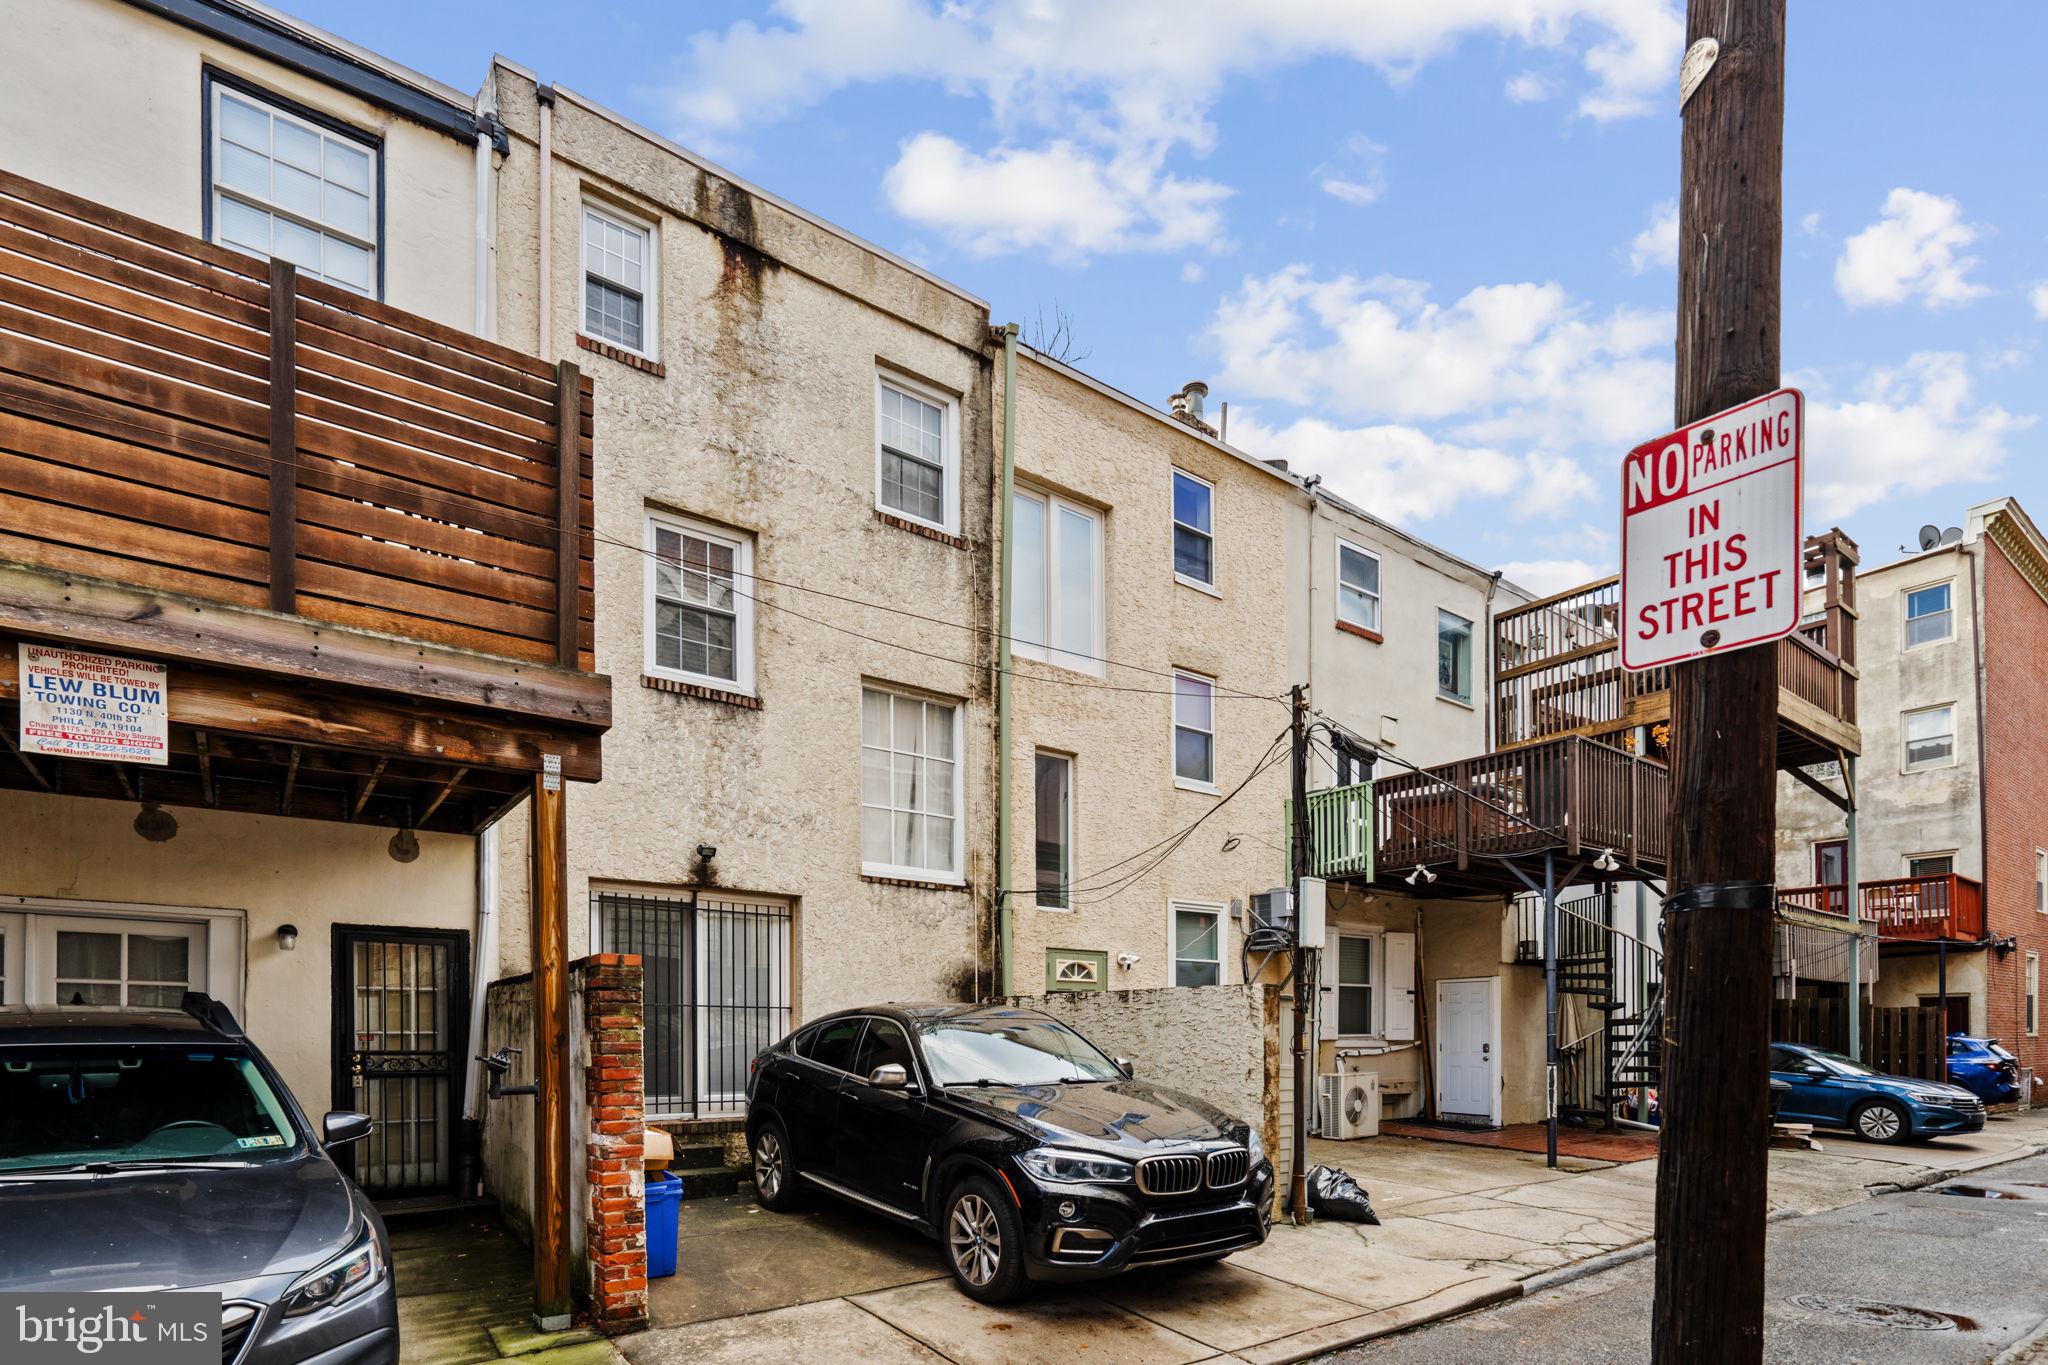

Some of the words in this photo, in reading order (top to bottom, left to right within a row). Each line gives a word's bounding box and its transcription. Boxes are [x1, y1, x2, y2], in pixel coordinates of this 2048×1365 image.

[1628, 442, 1685, 510] NO
[1693, 410, 1790, 478] PARKING
[1689, 499, 1720, 539] IN
[1663, 533, 1748, 589] THIS
[1638, 569, 1781, 641] STREET
[28, 647, 112, 666] UNAUTHORIZED
[28, 665, 74, 678] VEHICLES
[76, 671, 99, 682] WILL
[100, 675, 112, 684] BE
[114, 677, 147, 688] TOWED
[148, 681, 160, 689] BY
[62, 660, 129, 677] PROHIBITED!
[28, 673, 83, 694] LEW
[93, 682, 160, 705] BLUM
[34, 691, 107, 710] TOWING
[118, 701, 145, 715] CO.
[57, 707, 82, 717] 1130
[86, 710, 97, 719] N.
[100, 712, 122, 721] 40th
[126, 715, 139, 723] ST
[29, 720, 59, 730] Charge
[61, 724, 80, 733] $175
[91, 728, 105, 736] $25
[115, 731, 130, 739] Day
[131, 733, 161, 742] Storage
[29, 728, 63, 738] FREE
[66, 733, 119, 744] TOWING
[122, 739, 161, 749] SIGNS
[94, 721, 108, 729] PA
[112, 723, 142, 733] 19104
[36, 737, 62, 746] Call
[66, 740, 151, 755] 215-222-5628
